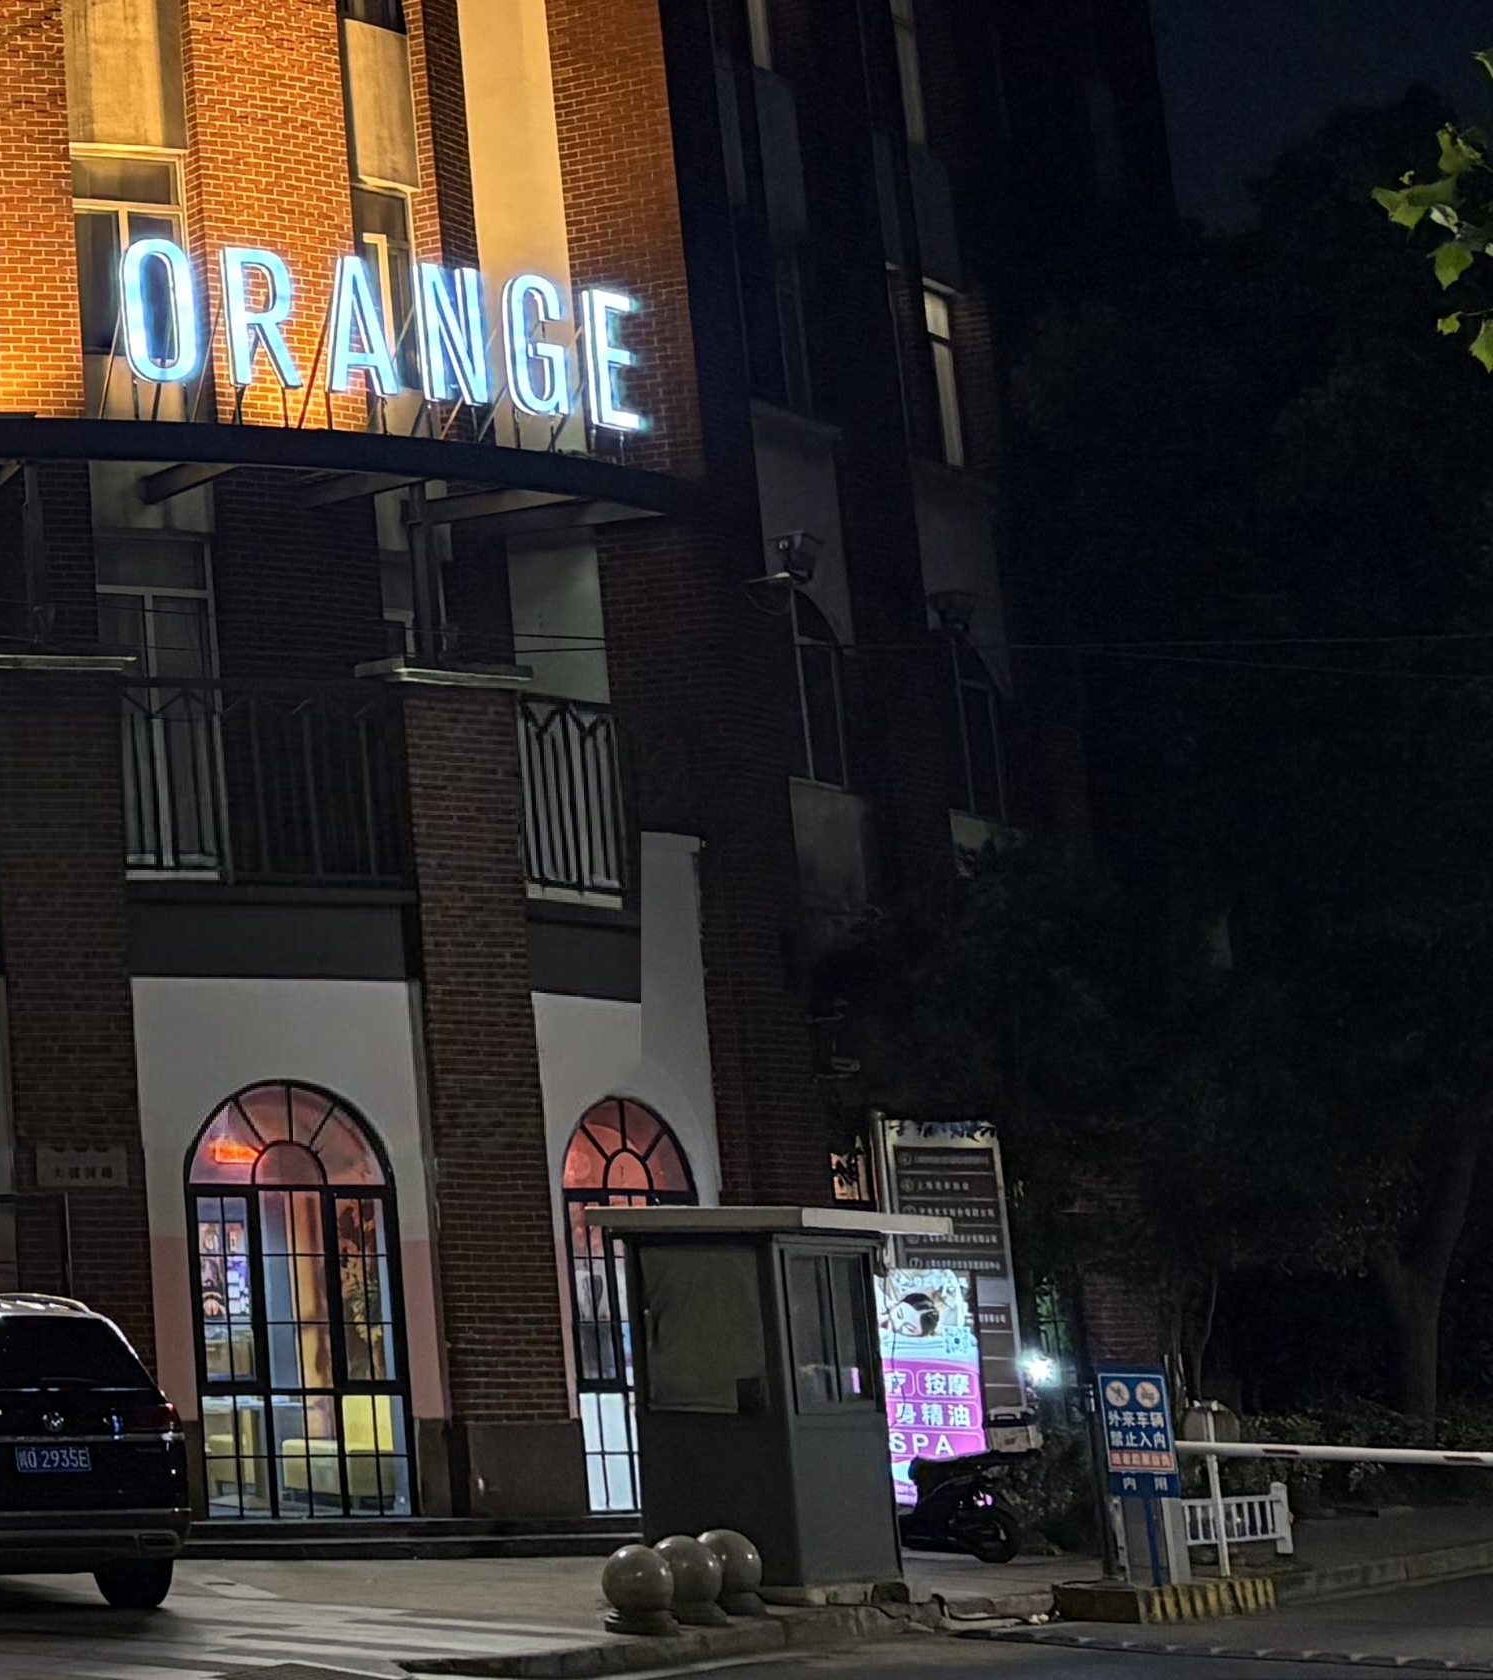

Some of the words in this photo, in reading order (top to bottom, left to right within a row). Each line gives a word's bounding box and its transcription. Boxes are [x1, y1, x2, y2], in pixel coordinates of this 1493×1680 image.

[119, 237, 649, 433] ORANGE
[924, 1372, 971, 1397] 按摩
[888, 1432, 956, 1457] SPA
